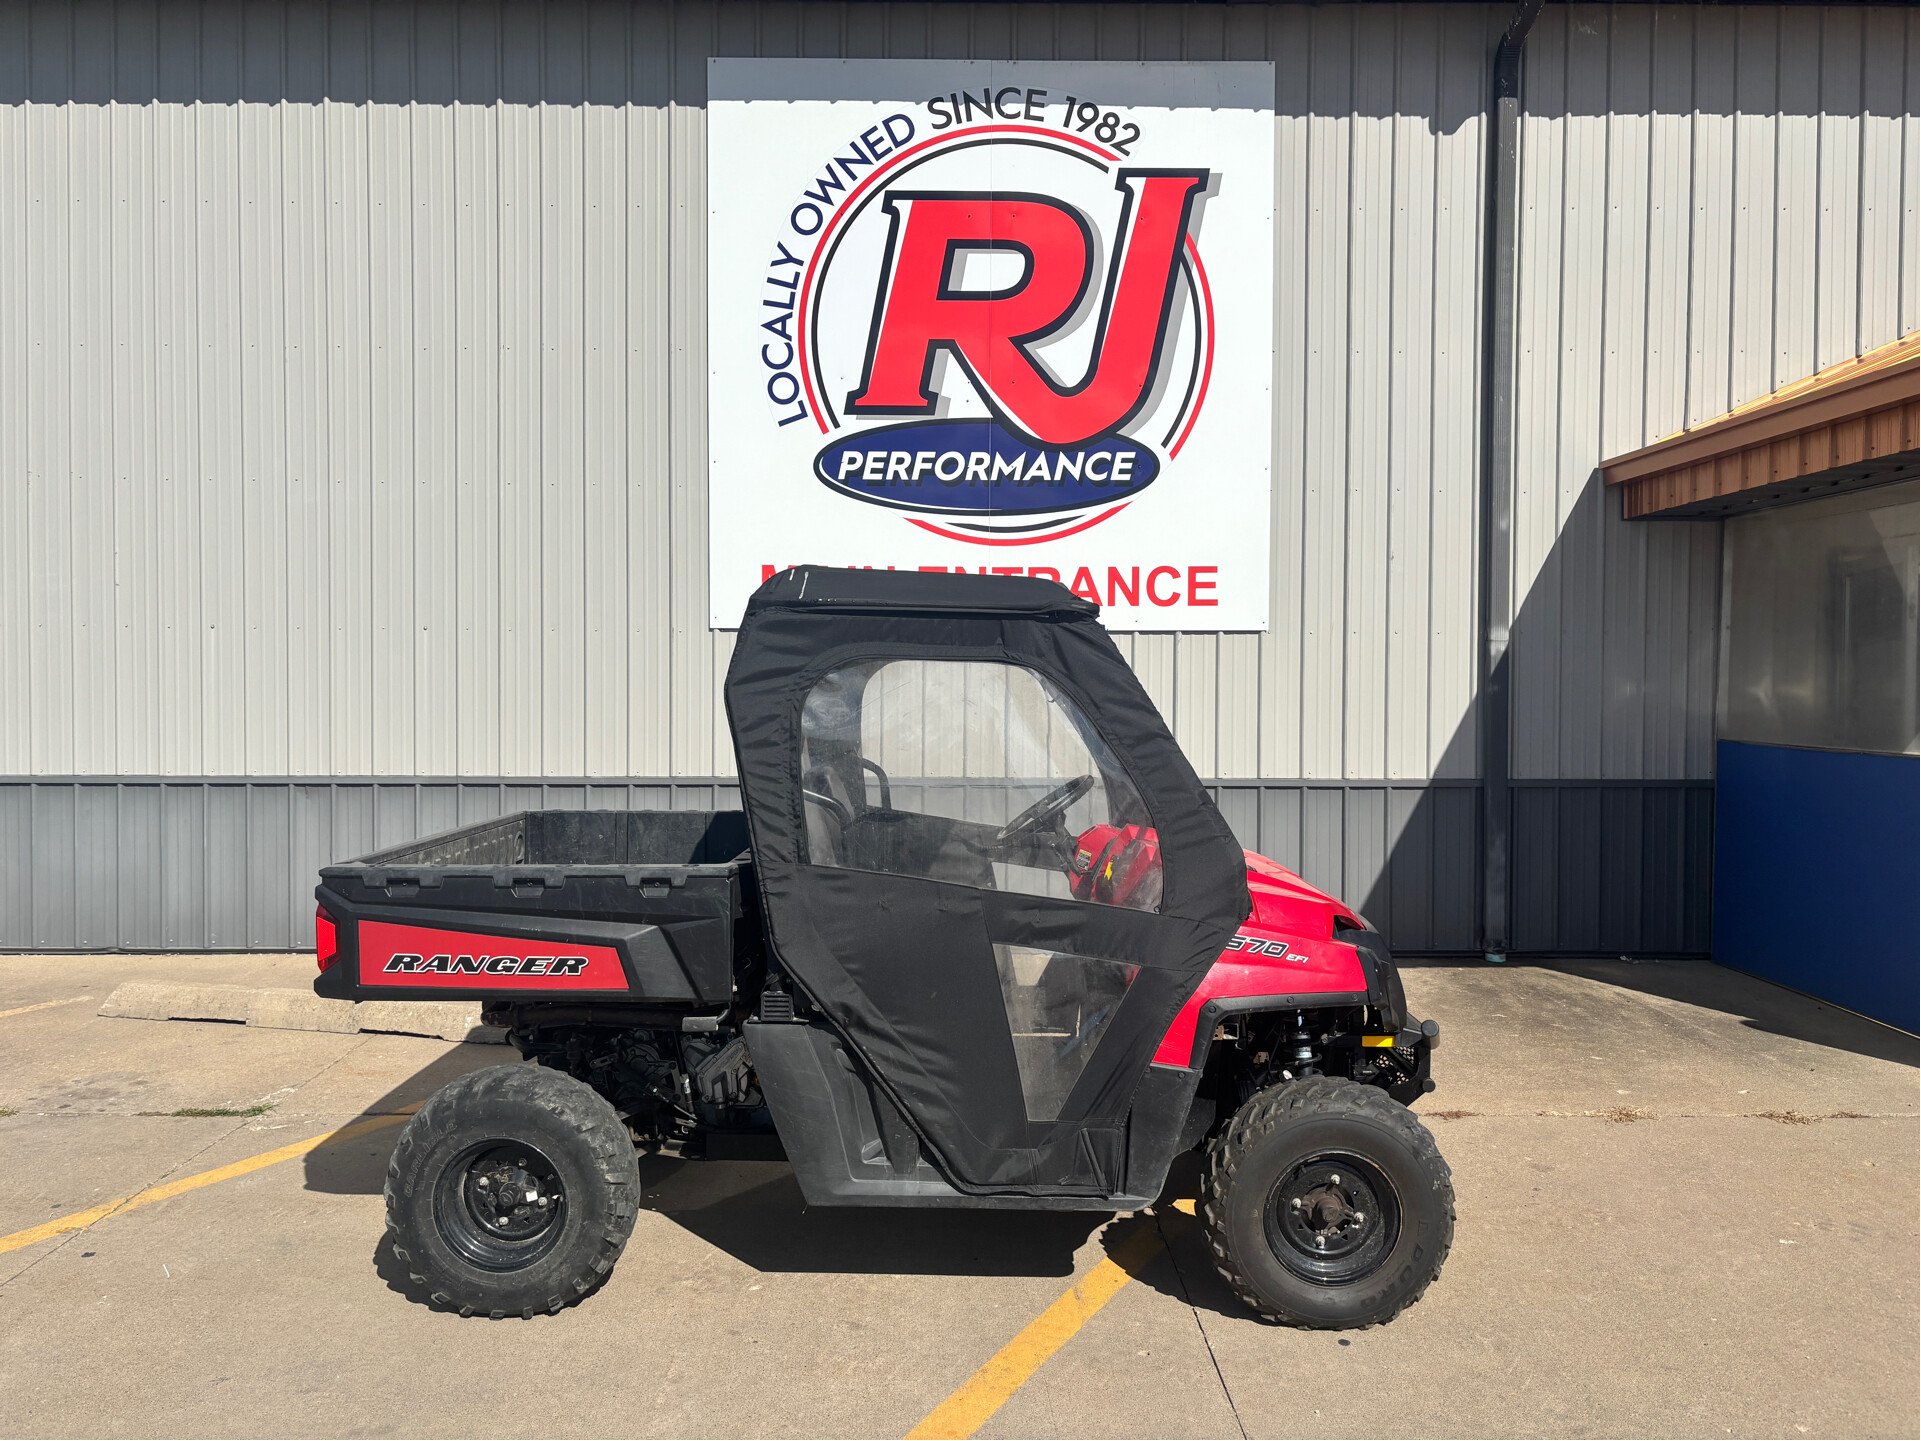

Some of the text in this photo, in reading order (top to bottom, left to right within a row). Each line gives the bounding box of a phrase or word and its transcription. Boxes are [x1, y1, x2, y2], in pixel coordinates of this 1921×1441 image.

[762, 87, 1141, 427] LOCALLY OWNED SINCE 1982
[845, 168, 1211, 447] RJ
[838, 450, 1136, 483] PERFORMANCE
[918, 566, 1219, 607] ANCE
[383, 953, 588, 975] RANGER
[1226, 934, 1309, 964] 570 EFI
